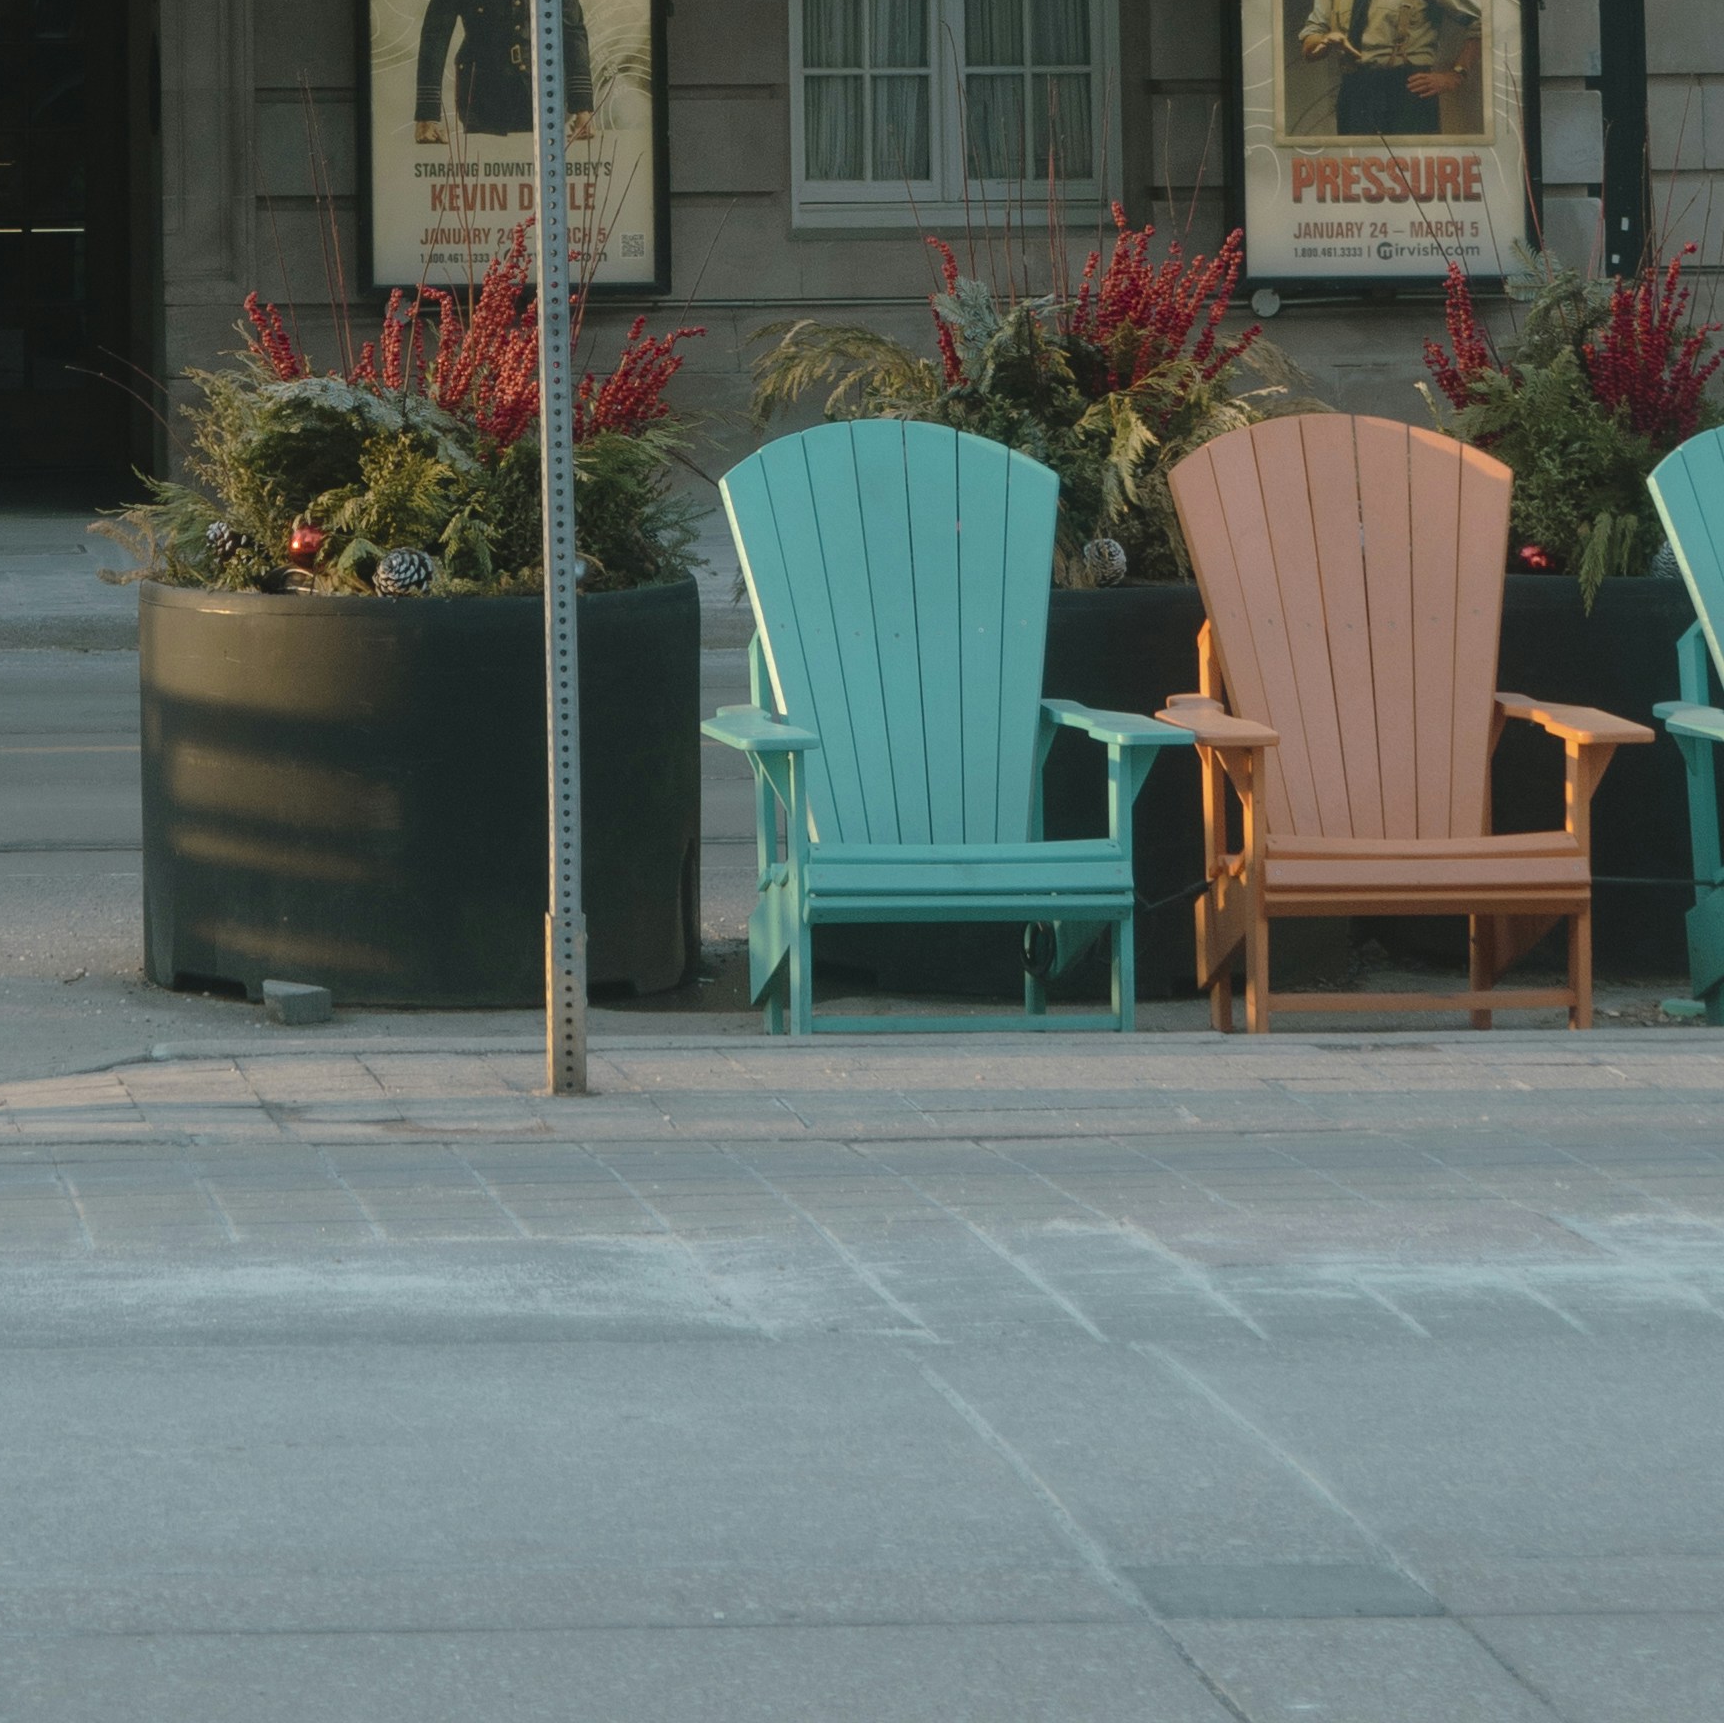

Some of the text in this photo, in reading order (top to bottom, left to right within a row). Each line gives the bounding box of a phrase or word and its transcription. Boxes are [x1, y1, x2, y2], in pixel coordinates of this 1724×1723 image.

[414, 161, 612, 177] STARRING DOWNT BBEY'S
[1291, 155, 1482, 204] PRESSURE
[429, 183, 597, 211] KEVIN DLE
[420, 228, 492, 245] JANUARY
[597, 227, 607, 244] 5
[1293, 221, 1364, 240] JANUARY
[1369, 221, 1388, 239] 24
[1410, 220, 1465, 239] MARCH
[1470, 220, 1480, 238] 5
